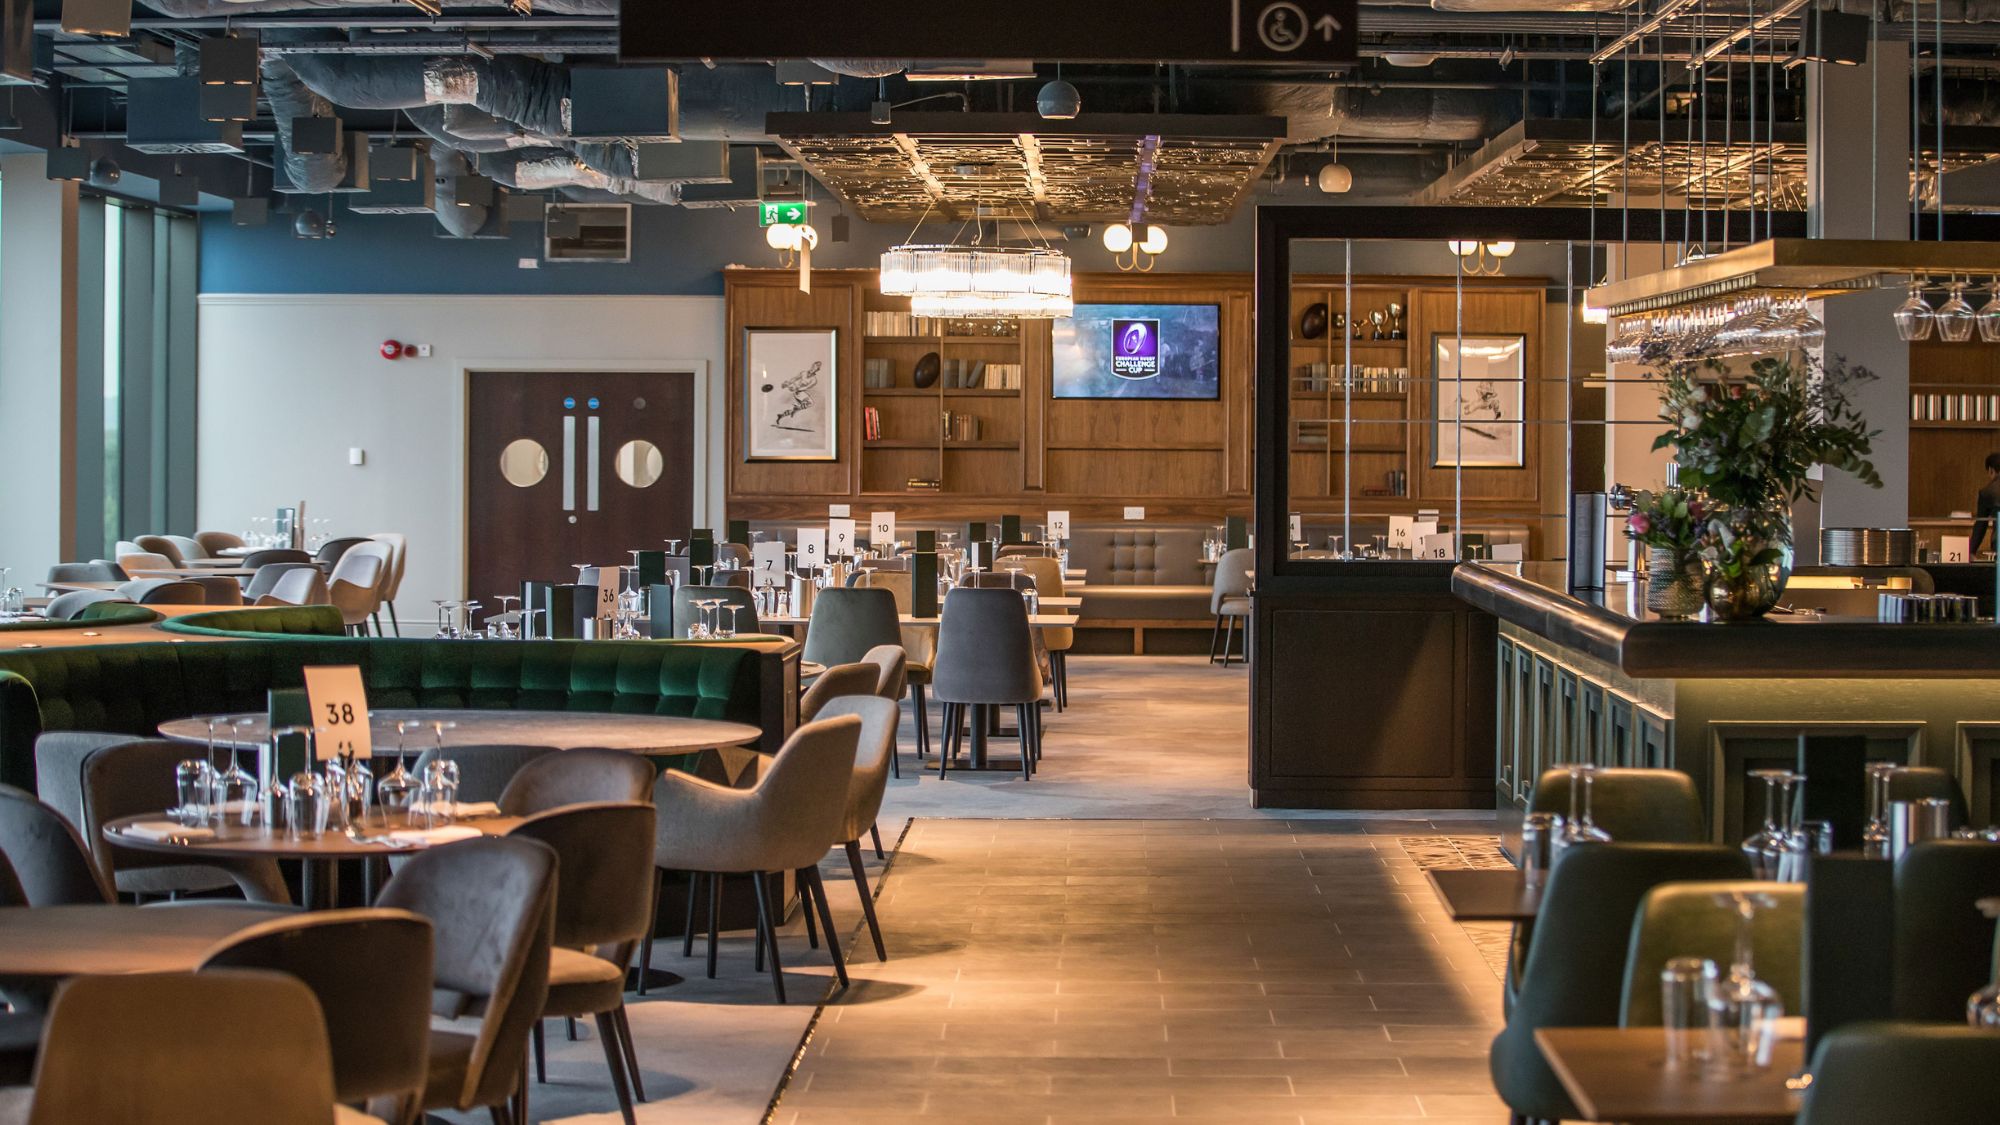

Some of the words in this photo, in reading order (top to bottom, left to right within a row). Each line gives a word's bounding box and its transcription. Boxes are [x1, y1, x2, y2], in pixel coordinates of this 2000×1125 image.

[1115, 360, 1155, 368] CHALLENGE
[878, 524, 889, 533] 10
[1053, 521, 1063, 529] 12
[1396, 528, 1406, 537] 16
[838, 533, 845, 543] 9
[807, 543, 815, 554] 8
[1433, 548, 1446, 558] 18
[1949, 552, 1961, 562] 21
[766, 559, 773, 571] 7
[603, 588, 615, 603] 36
[326, 703, 355, 725] 38
